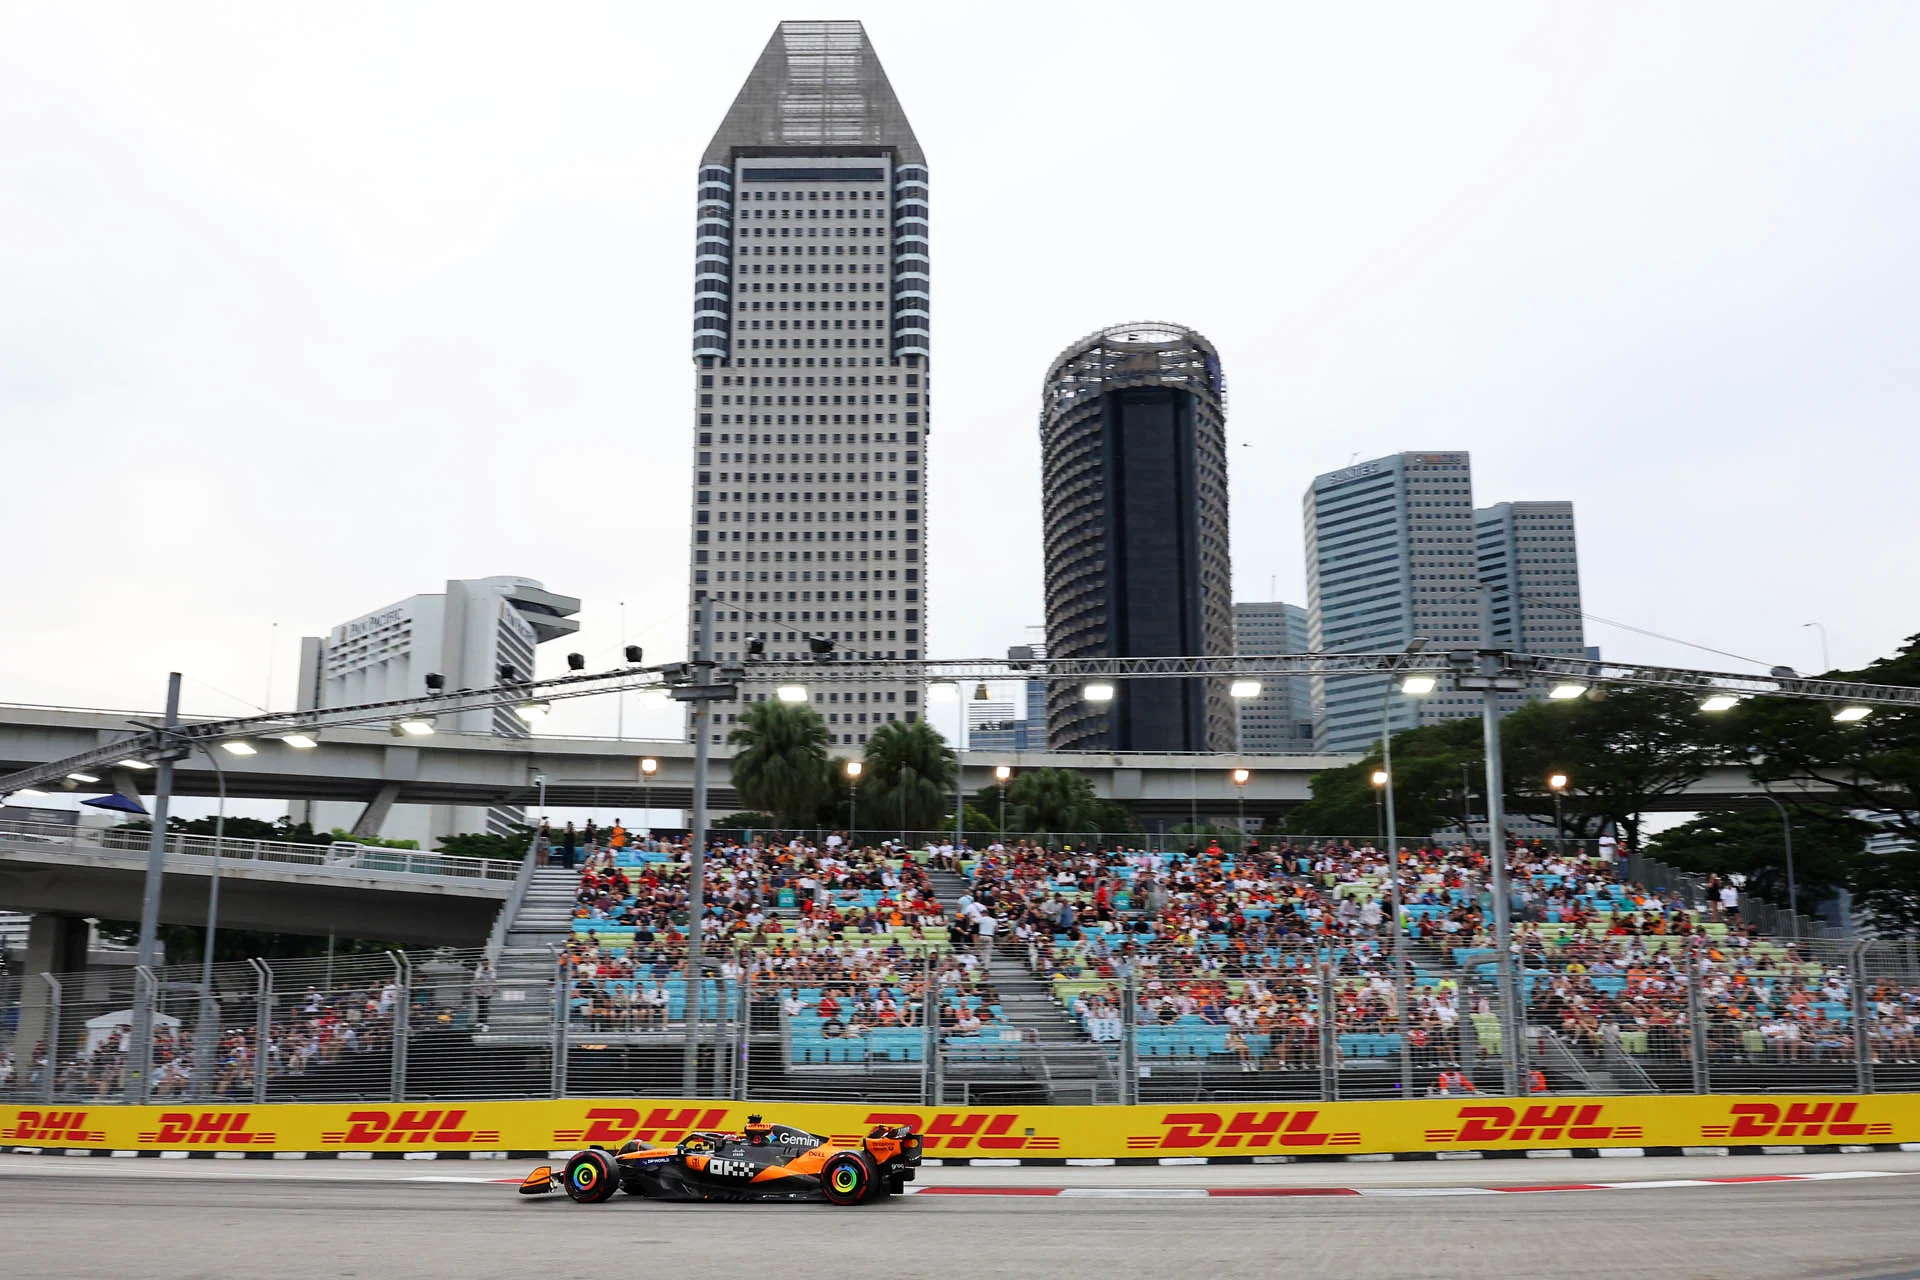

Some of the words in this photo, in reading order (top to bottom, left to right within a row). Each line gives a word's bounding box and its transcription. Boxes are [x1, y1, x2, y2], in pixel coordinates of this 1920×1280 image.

[16, 1111, 91, 1141] DHL
[158, 1113, 254, 1144] DHL
[343, 1110, 474, 1144] DHL
[1159, 1112, 1329, 1149] DHL
[1455, 1105, 1613, 1142] DHL
[1728, 1102, 1869, 1138] DHL
[780, 1132, 819, 1147] Gemini
